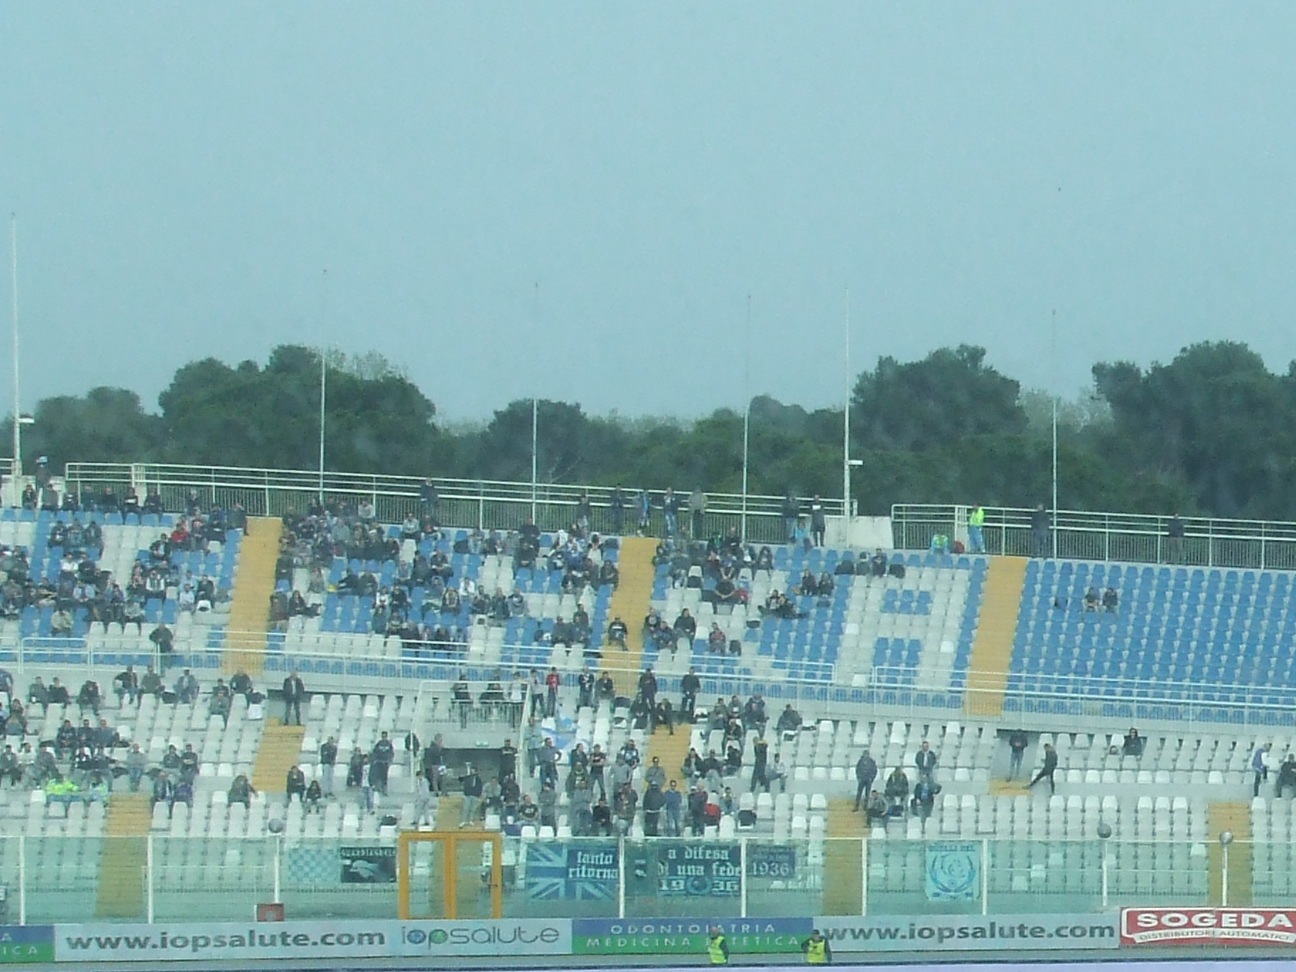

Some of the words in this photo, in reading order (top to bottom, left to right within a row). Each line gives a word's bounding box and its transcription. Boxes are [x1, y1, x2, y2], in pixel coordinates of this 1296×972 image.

[684, 846, 730, 860] difesa
[568, 864, 619, 879] ritorna
[677, 864, 705, 876] una
[752, 861, 790, 876] 1936
[1136, 913, 1293, 928] SOGEDA
[610, 924, 776, 935] ODONTOIATRIA
[823, 921, 1115, 943] www.iopsalute.com
[66, 929, 386, 952] www.iopsalute.com
[401, 926, 561, 950] iopsalute
[586, 937, 692, 948] MEDICINA
[705, 936, 799, 946] ETETICA
